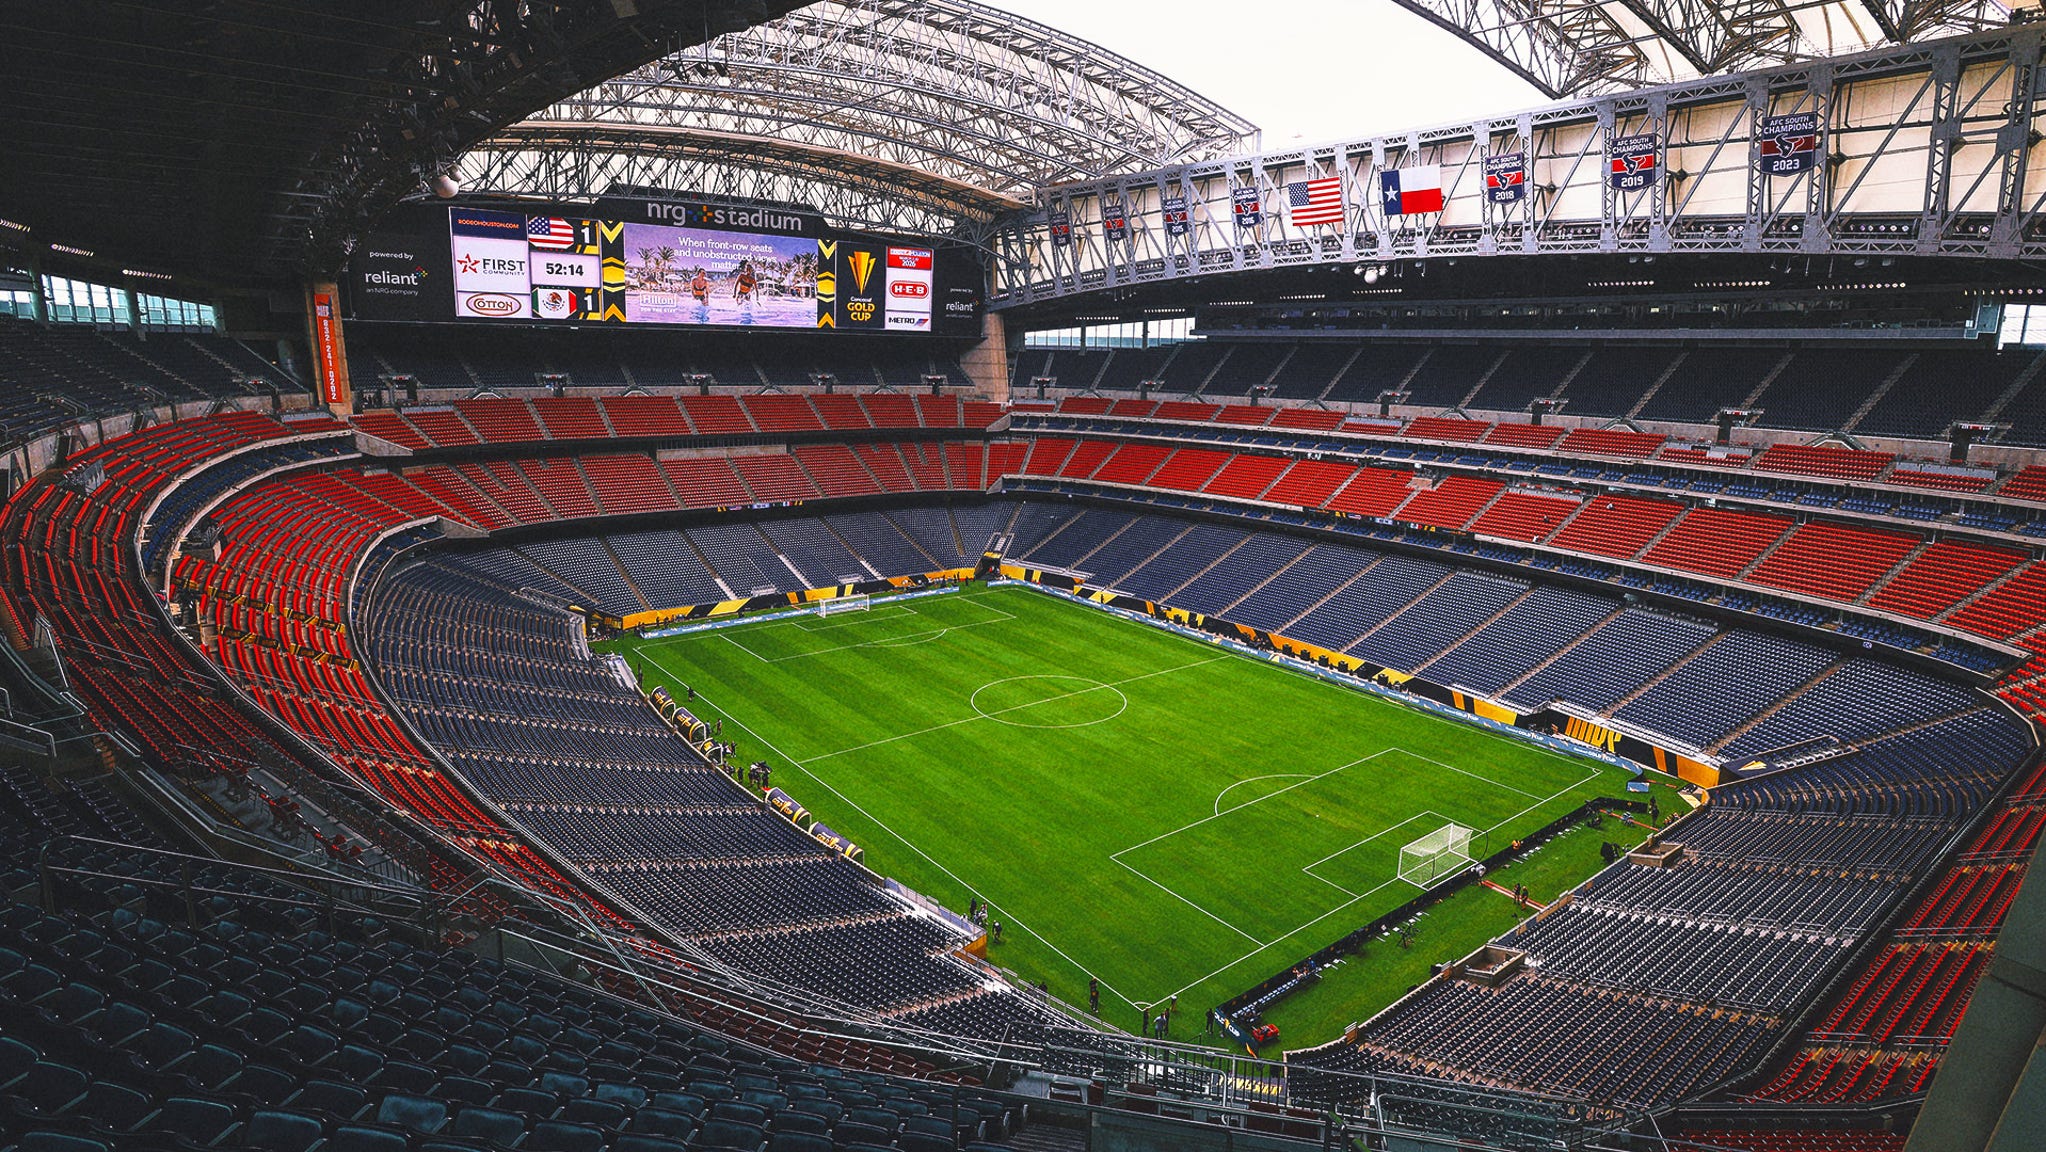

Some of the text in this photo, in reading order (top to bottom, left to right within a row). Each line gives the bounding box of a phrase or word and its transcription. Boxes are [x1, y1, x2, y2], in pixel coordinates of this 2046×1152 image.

[1785, 116, 1809, 125] SOUTH
[1763, 121, 1814, 134] CHAMPIONS
[1612, 142, 1654, 154] CHAMPIONS
[1487, 161, 1522, 170] CHAMPIONS
[1772, 159, 1800, 171] 2023
[1621, 176, 1644, 187] 2019
[1495, 191, 1515, 200] 2018
[647, 203, 802, 231] nrg stadium
[457, 219, 519, 228] RODEOHOUSTON.COM
[581, 227, 590, 244] 1
[679, 236, 773, 253] When front-row seats
[369, 251, 414, 260] powered by
[674, 248, 777, 263] and unobstructed views
[483, 259, 525, 271] FIRST
[546, 263, 584, 276] 52:14
[365, 270, 419, 286] reliant
[474, 298, 513, 311] COTTON
[584, 294, 592, 311] 1
[643, 295, 674, 305] Hilton
[847, 302, 875, 313] GOLD
[946, 301, 973, 312] reliant
[851, 312, 872, 322] CUP
